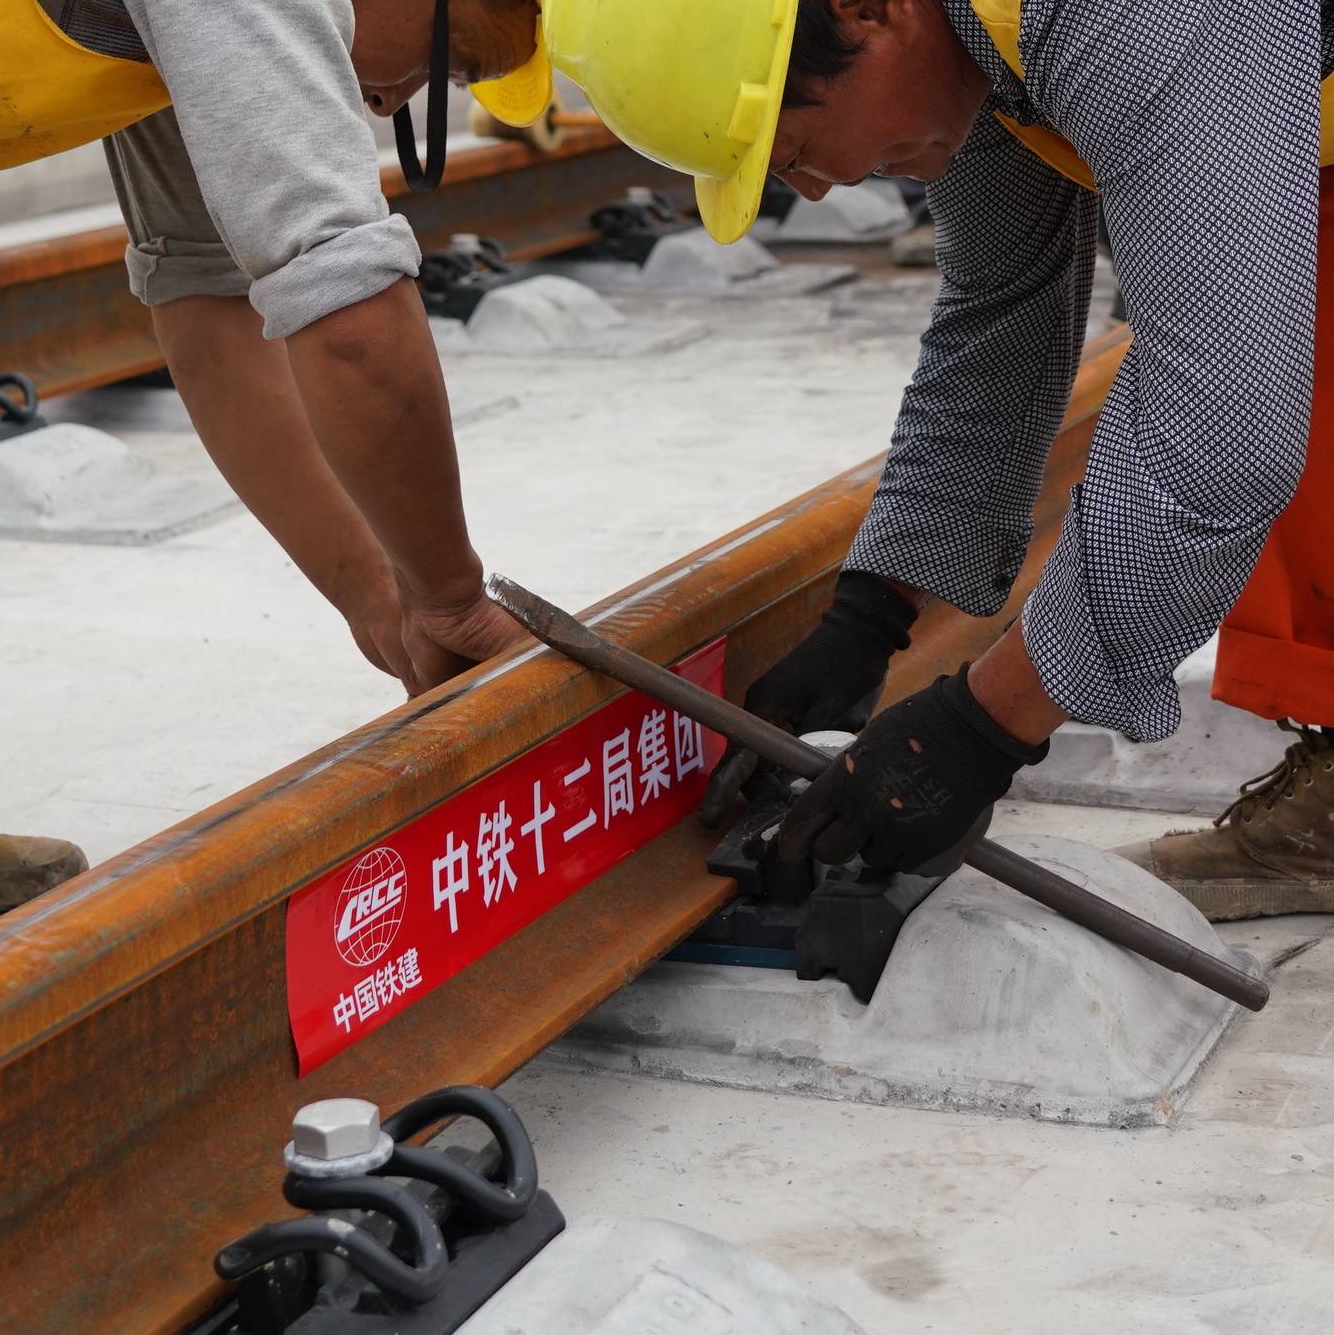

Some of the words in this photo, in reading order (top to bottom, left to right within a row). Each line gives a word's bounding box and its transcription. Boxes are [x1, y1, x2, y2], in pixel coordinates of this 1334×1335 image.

[432, 708, 705, 934] 中铁十二局集团
[336, 870, 405, 944] CRCC
[332, 946, 423, 1034] 中国铁建
